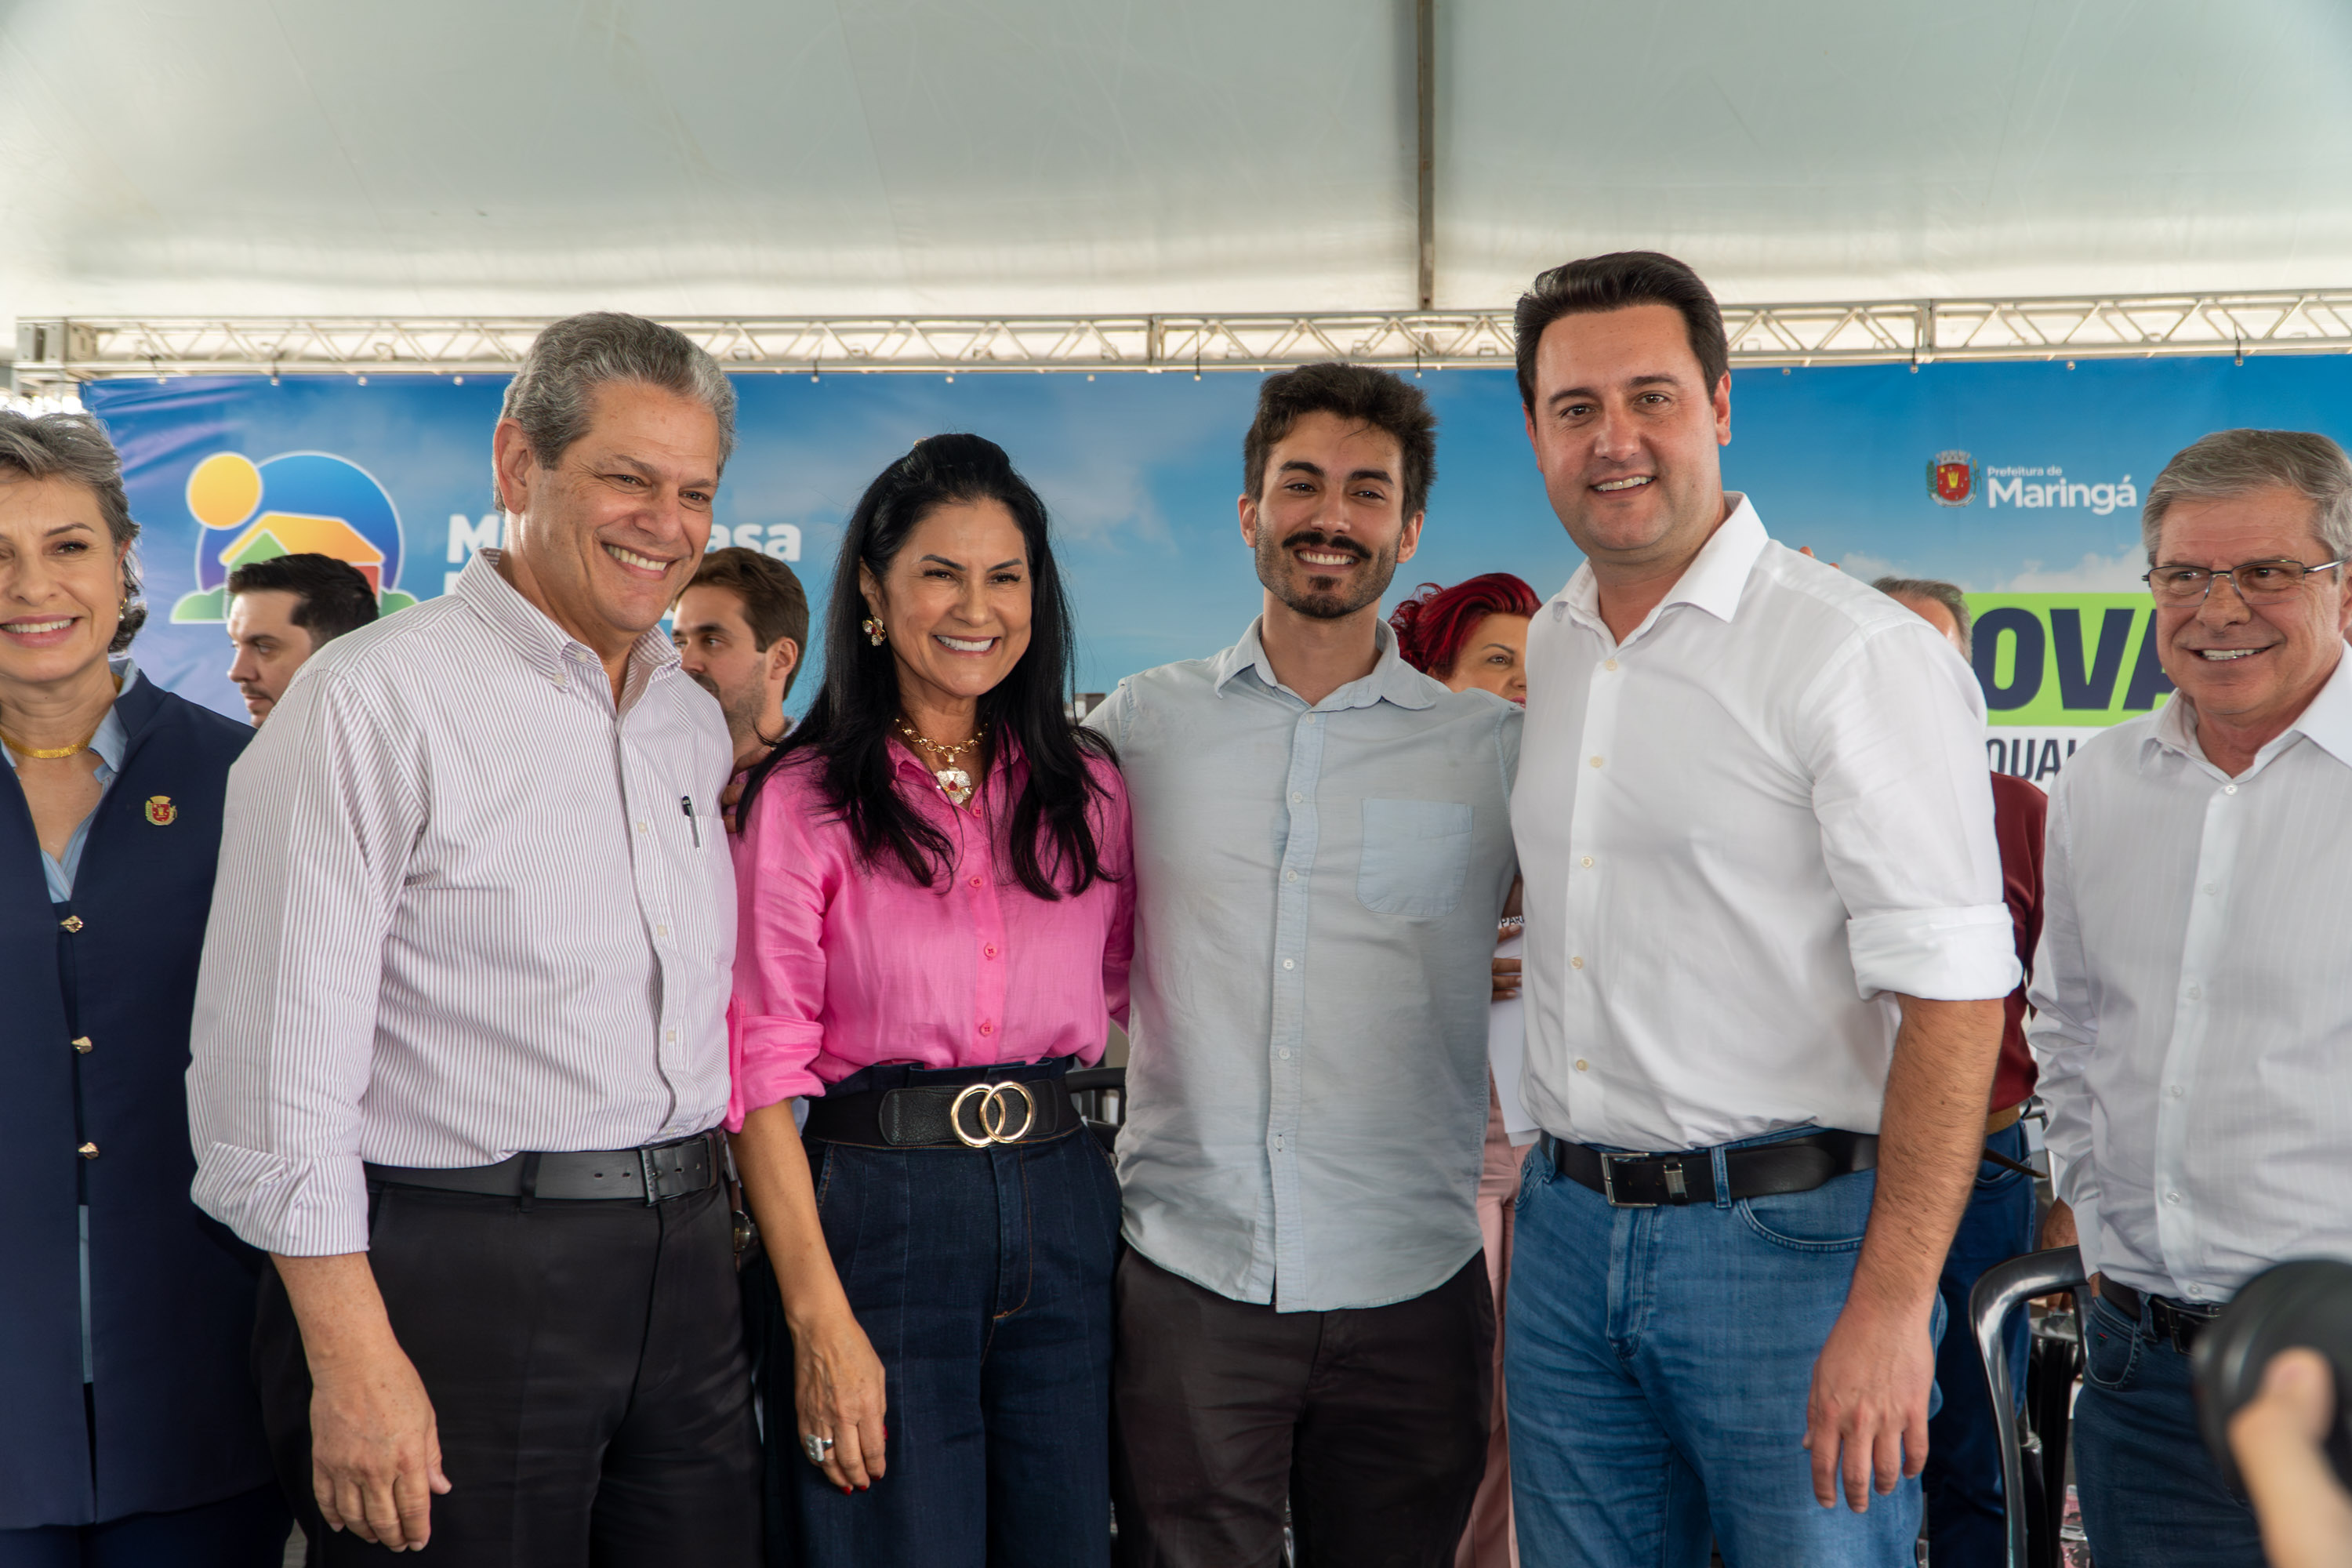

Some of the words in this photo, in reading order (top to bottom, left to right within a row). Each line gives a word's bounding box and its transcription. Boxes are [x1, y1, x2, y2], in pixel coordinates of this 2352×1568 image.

[1987, 466, 2044, 477] Prefeitura
[2046, 465, 2063, 476] de
[1988, 474, 2137, 515] Maringá
[705, 523, 801, 562] asa
[1972, 607, 2176, 711] OVA
